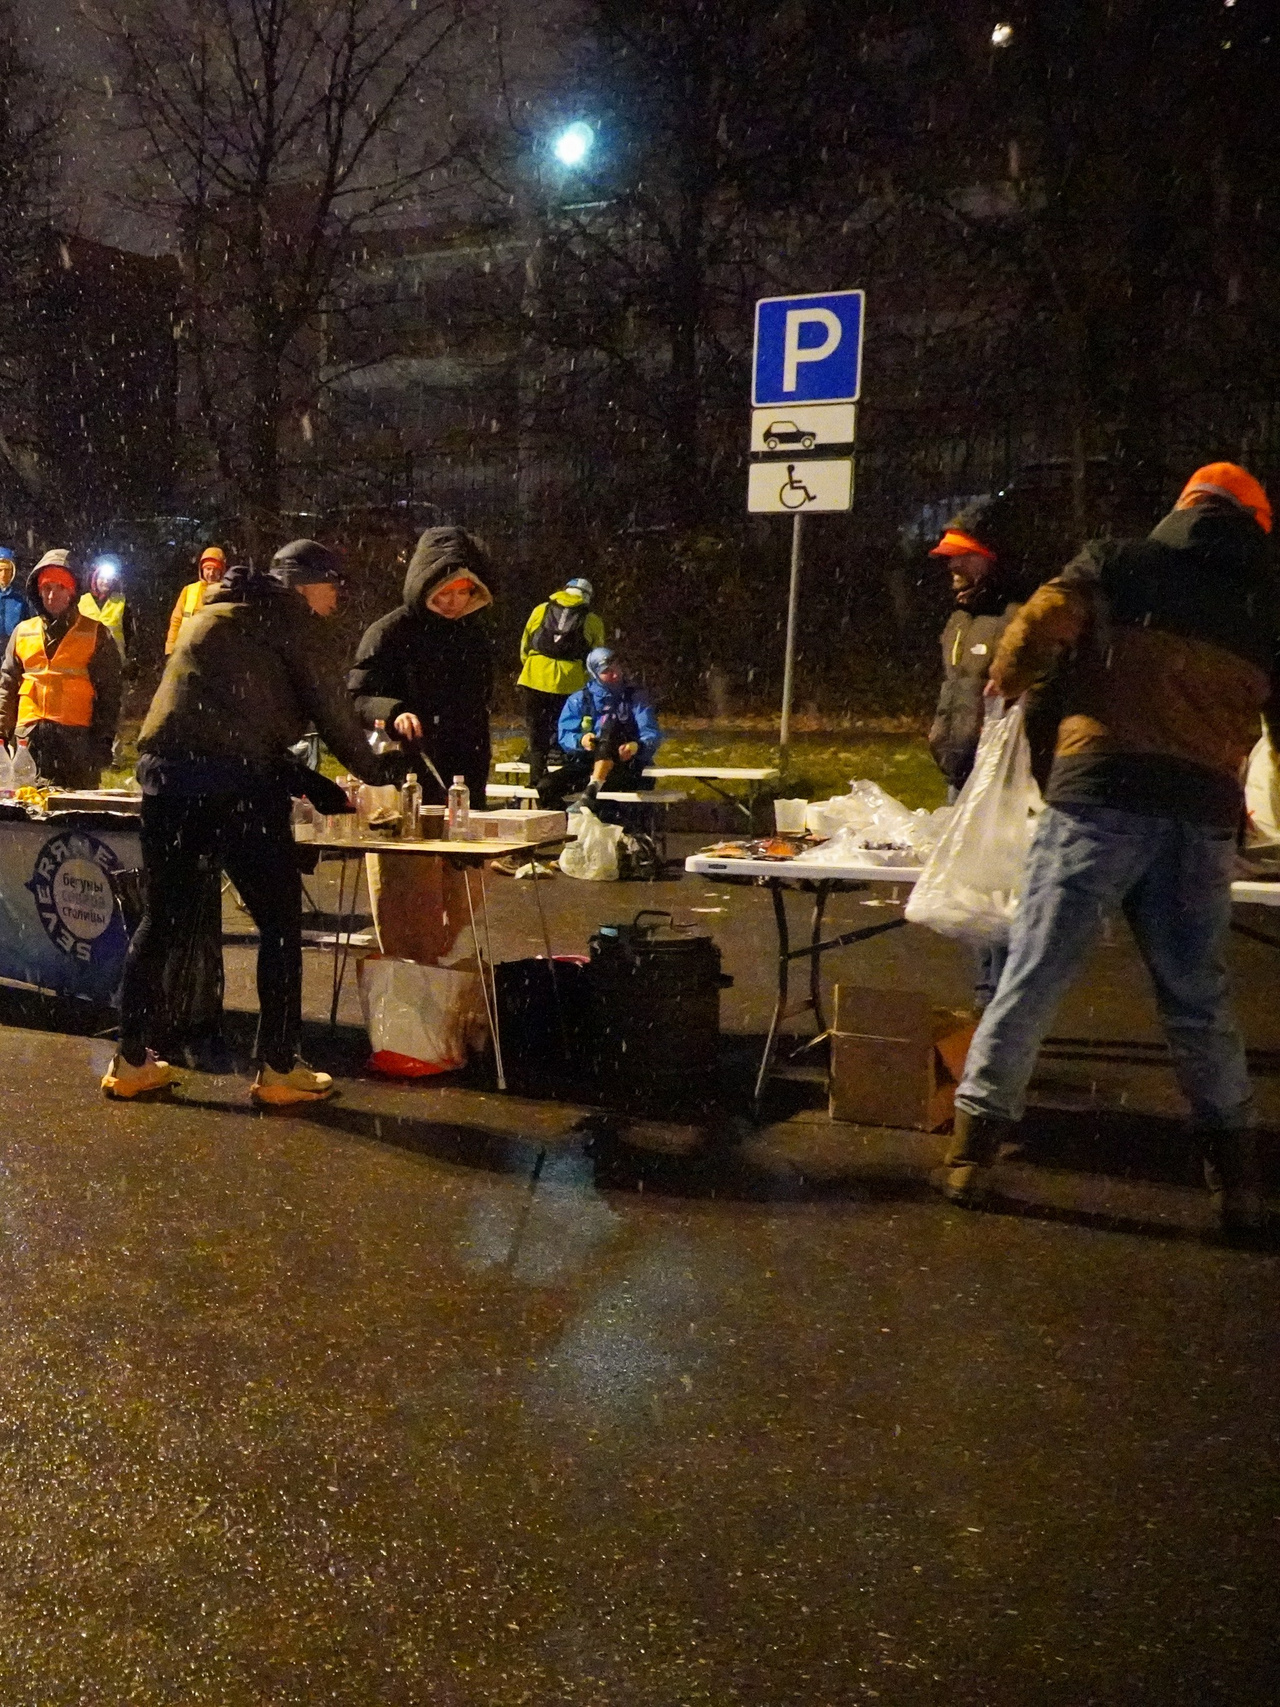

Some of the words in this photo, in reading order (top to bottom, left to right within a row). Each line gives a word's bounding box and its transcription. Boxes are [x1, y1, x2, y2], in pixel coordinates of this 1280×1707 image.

[783, 308, 842, 392] P
[62, 872, 104, 893] бегуны
[62, 906, 106, 926] столицы
